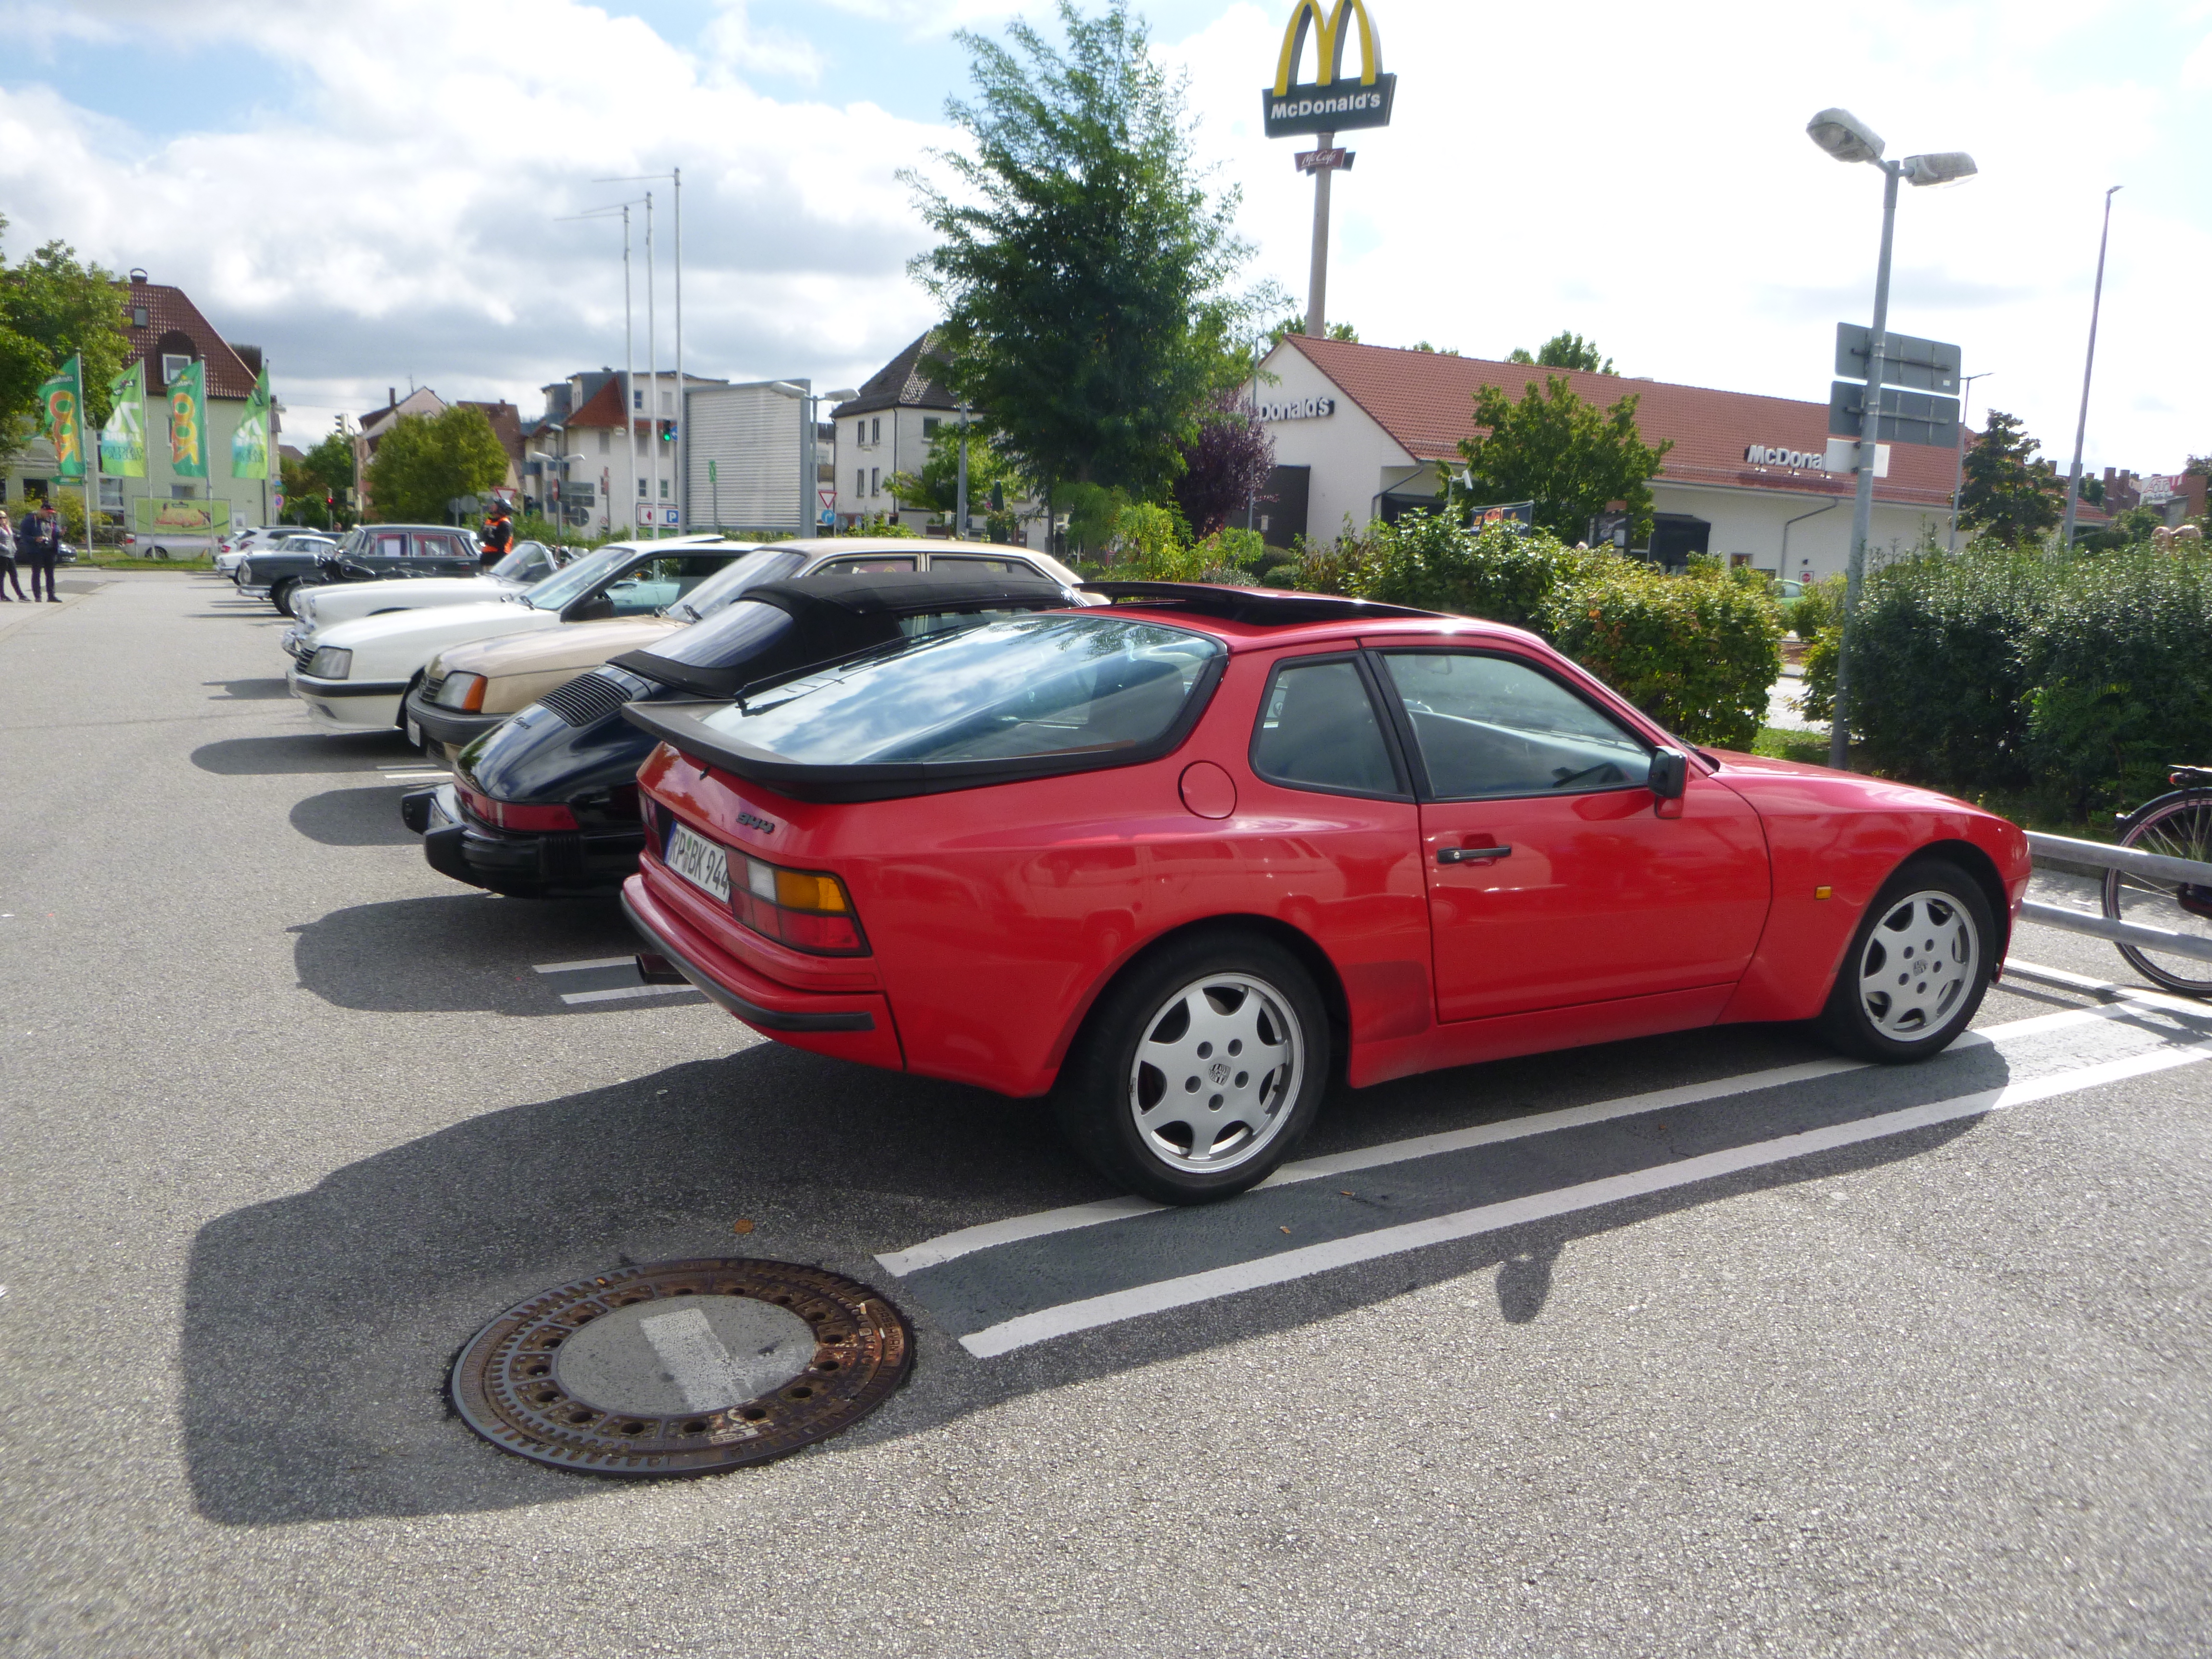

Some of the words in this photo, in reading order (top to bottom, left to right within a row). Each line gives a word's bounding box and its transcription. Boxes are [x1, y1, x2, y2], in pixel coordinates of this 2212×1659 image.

[1271, 92, 1381, 119] McDonald's
[735, 812, 775, 834] 944
[687, 839, 707, 881] BK
[705, 850, 728, 896] 944
